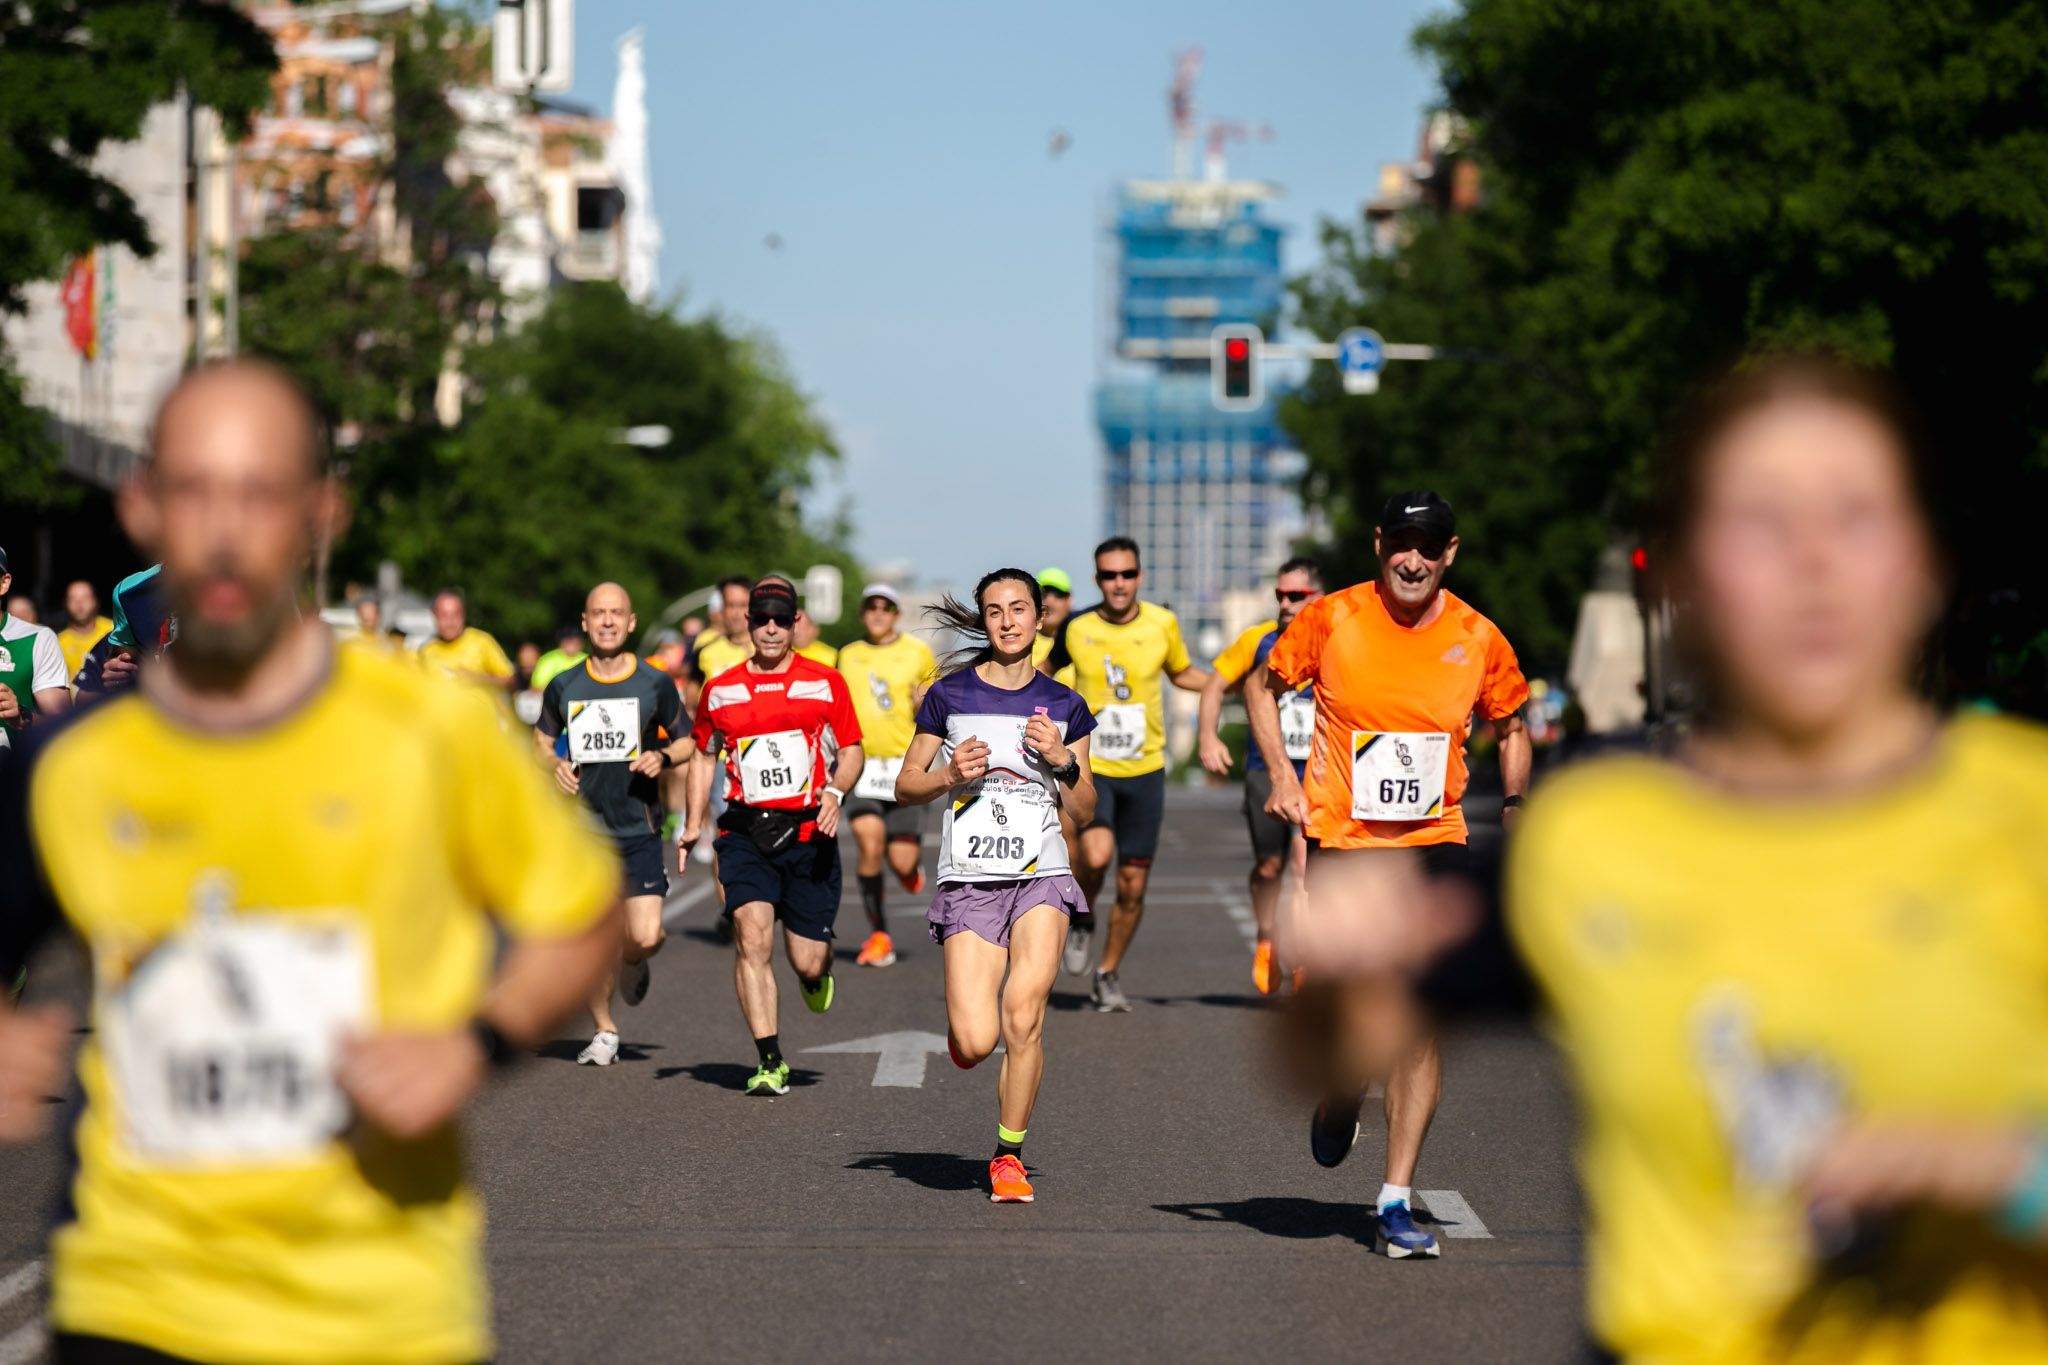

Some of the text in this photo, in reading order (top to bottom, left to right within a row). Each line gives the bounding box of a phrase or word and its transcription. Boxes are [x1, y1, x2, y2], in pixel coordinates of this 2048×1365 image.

[582, 730, 625, 751] 2852
[761, 766, 793, 788] 851
[1379, 778, 1420, 804] 675
[968, 835, 1025, 860] 2203
